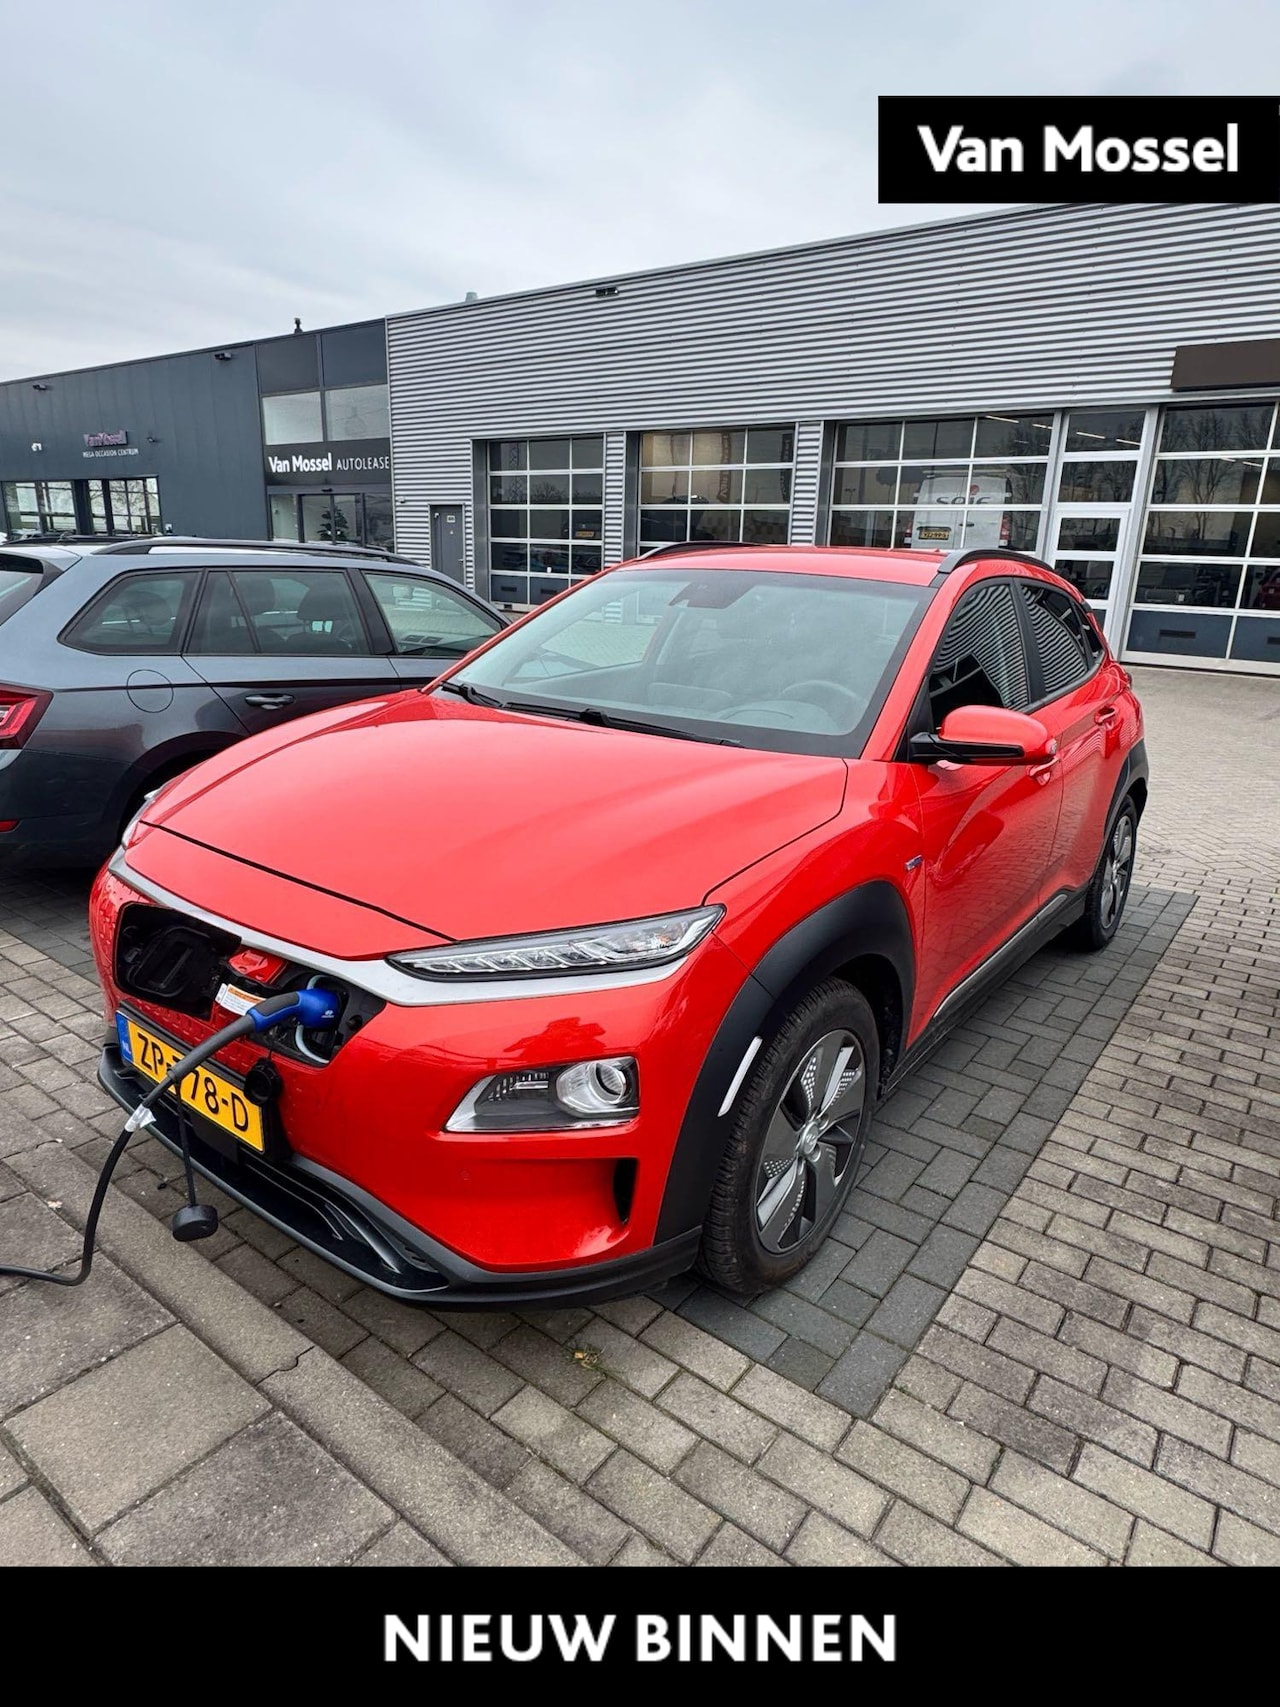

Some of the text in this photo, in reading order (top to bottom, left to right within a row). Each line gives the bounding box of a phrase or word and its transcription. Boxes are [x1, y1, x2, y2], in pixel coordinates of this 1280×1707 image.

[268, 452, 390, 473] Van Mossel AUTOLEASE
[137, 1033, 249, 1132] ZP-78-D
